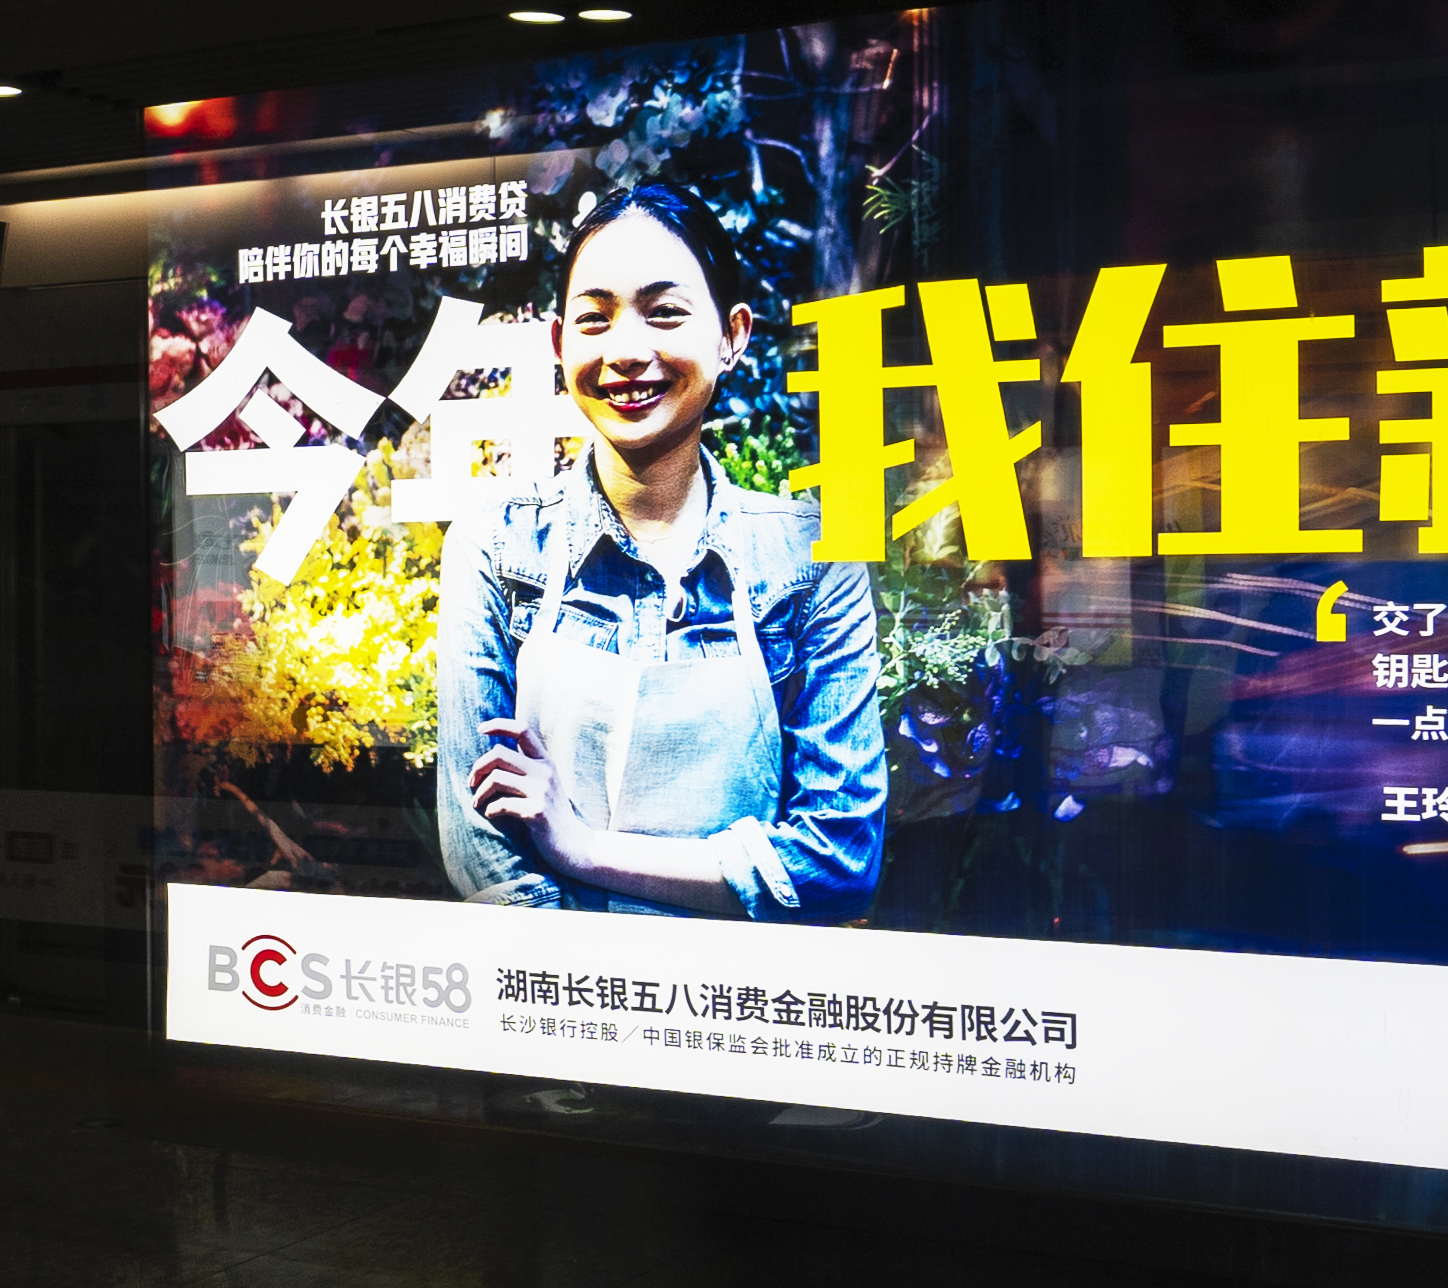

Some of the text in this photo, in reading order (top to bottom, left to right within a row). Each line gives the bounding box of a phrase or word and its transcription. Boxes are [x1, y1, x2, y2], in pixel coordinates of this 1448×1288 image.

[320, 180, 529, 236] 长银五八消费贷
[238, 224, 529, 284] 陪伴你的每个幸福瞬间
[152, 295, 594, 586] 今年
[207, 939, 473, 1014] BCS 长银58
[299, 1003, 347, 1018] 消费金融
[355, 1008, 471, 1030] CONSUMER FINANCE
[495, 966, 1080, 1051] 湖南长银五八消费金融股份有限公司
